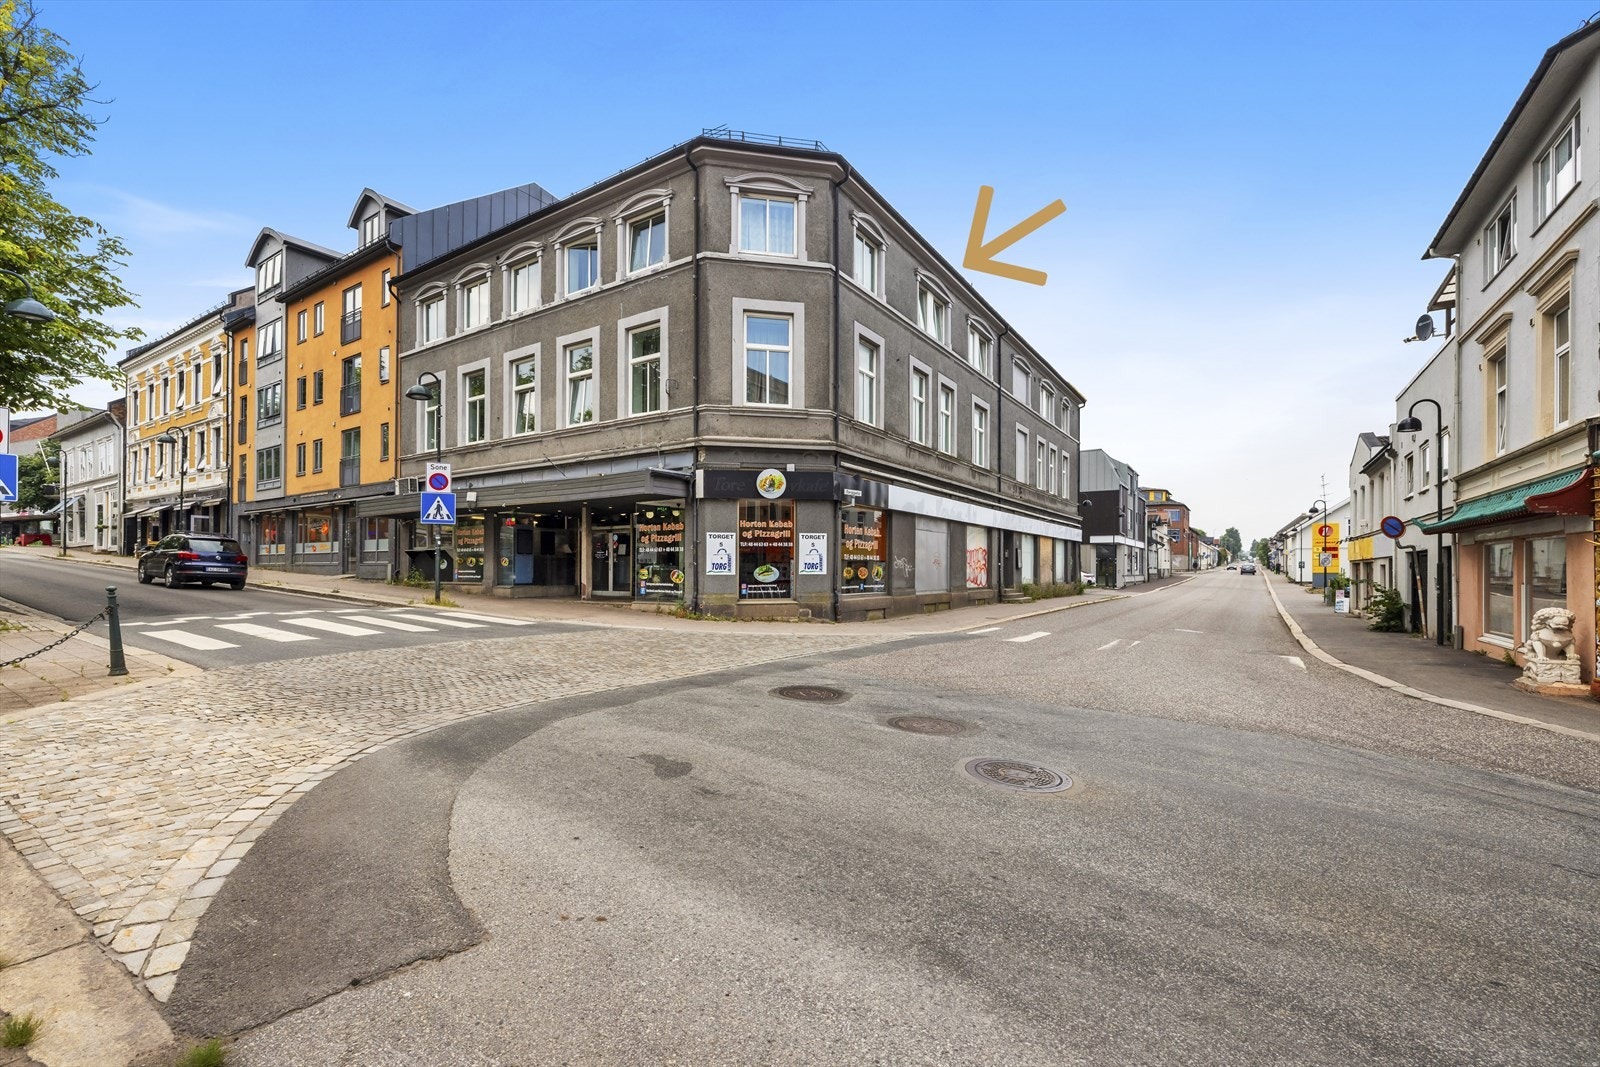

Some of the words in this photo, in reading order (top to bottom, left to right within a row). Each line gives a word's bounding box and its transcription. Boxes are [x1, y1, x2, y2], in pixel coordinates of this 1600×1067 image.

[662, 521, 684, 531] Kebab
[739, 520, 767, 528] Horten
[768, 520, 793, 528] Kebab
[742, 530, 753, 539] og
[754, 529, 791, 539] Pizzagrill
[844, 523, 863, 535] Horten
[864, 526, 880, 536] Kebab
[640, 535, 649, 544] og
[650, 533, 682, 543] Pizzagrill
[845, 539, 853, 550] og
[854, 538, 879, 551] Pizzagrill
[711, 562, 727, 570] TORG
[804, 562, 819, 570] TORG
